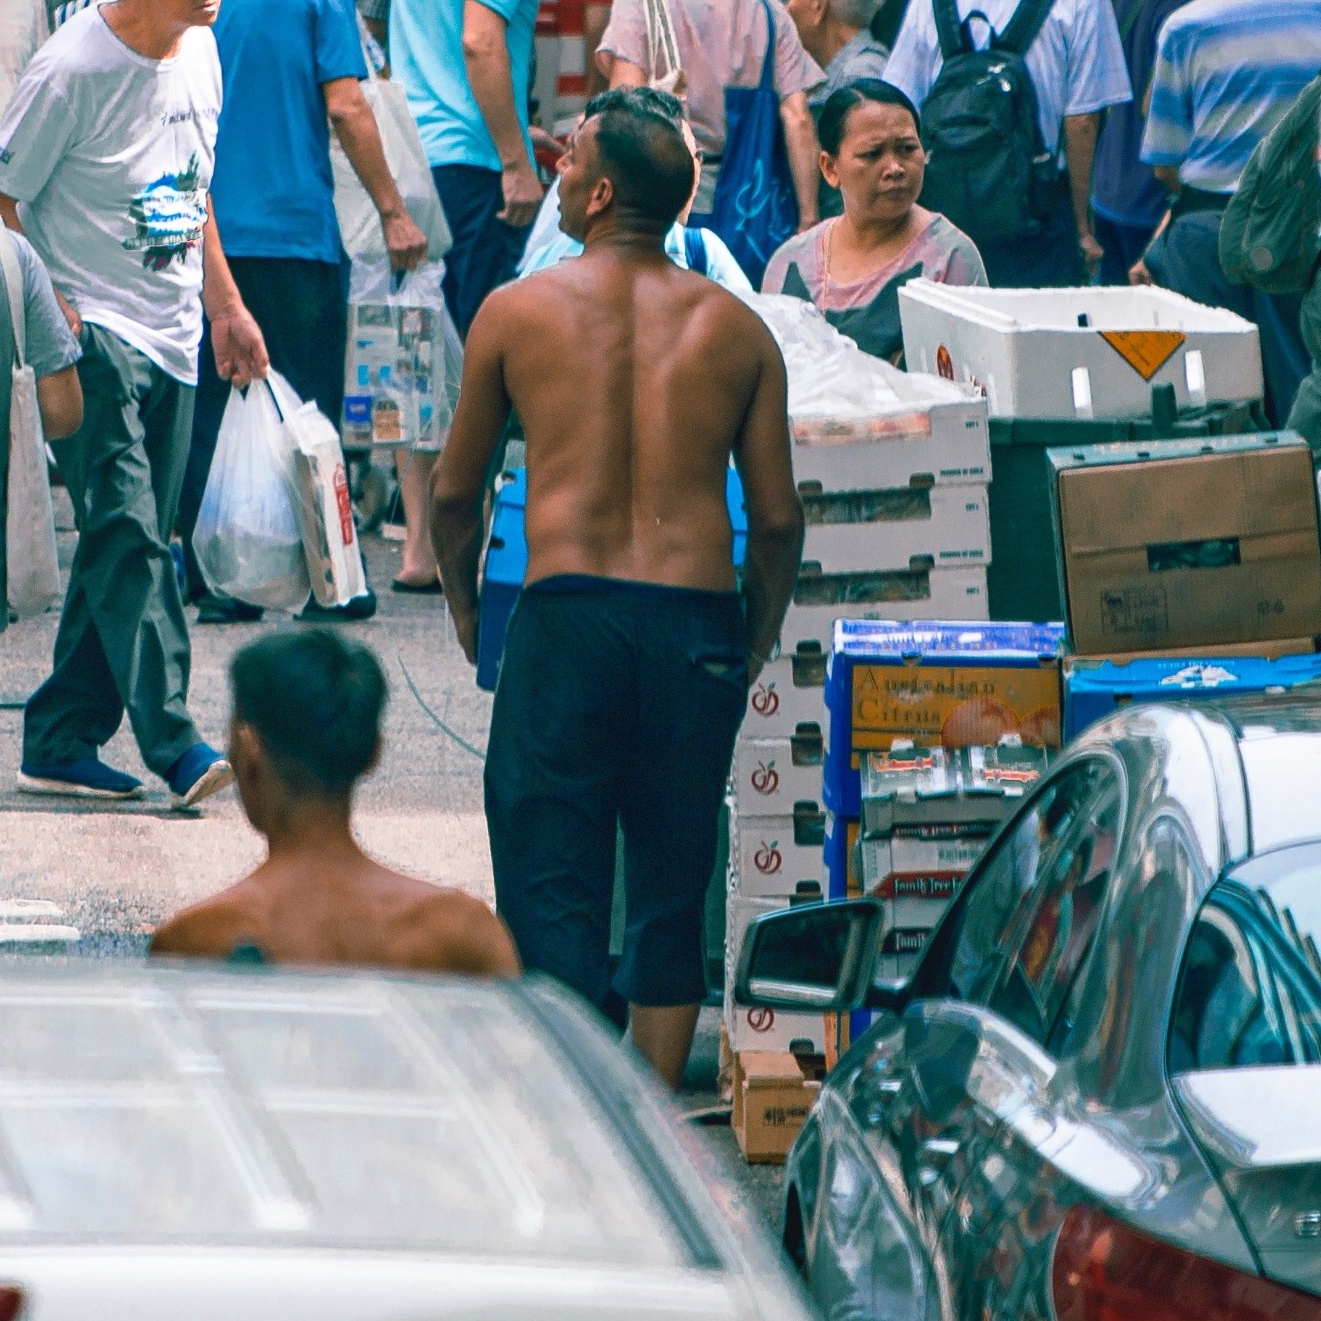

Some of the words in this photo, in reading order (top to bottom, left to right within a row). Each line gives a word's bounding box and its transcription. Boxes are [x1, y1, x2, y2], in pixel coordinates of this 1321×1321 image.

[859, 666, 996, 695] Australian
[856, 699, 942, 725] Citrus
[894, 877, 927, 895] Family
[930, 877, 951, 895] Tree
